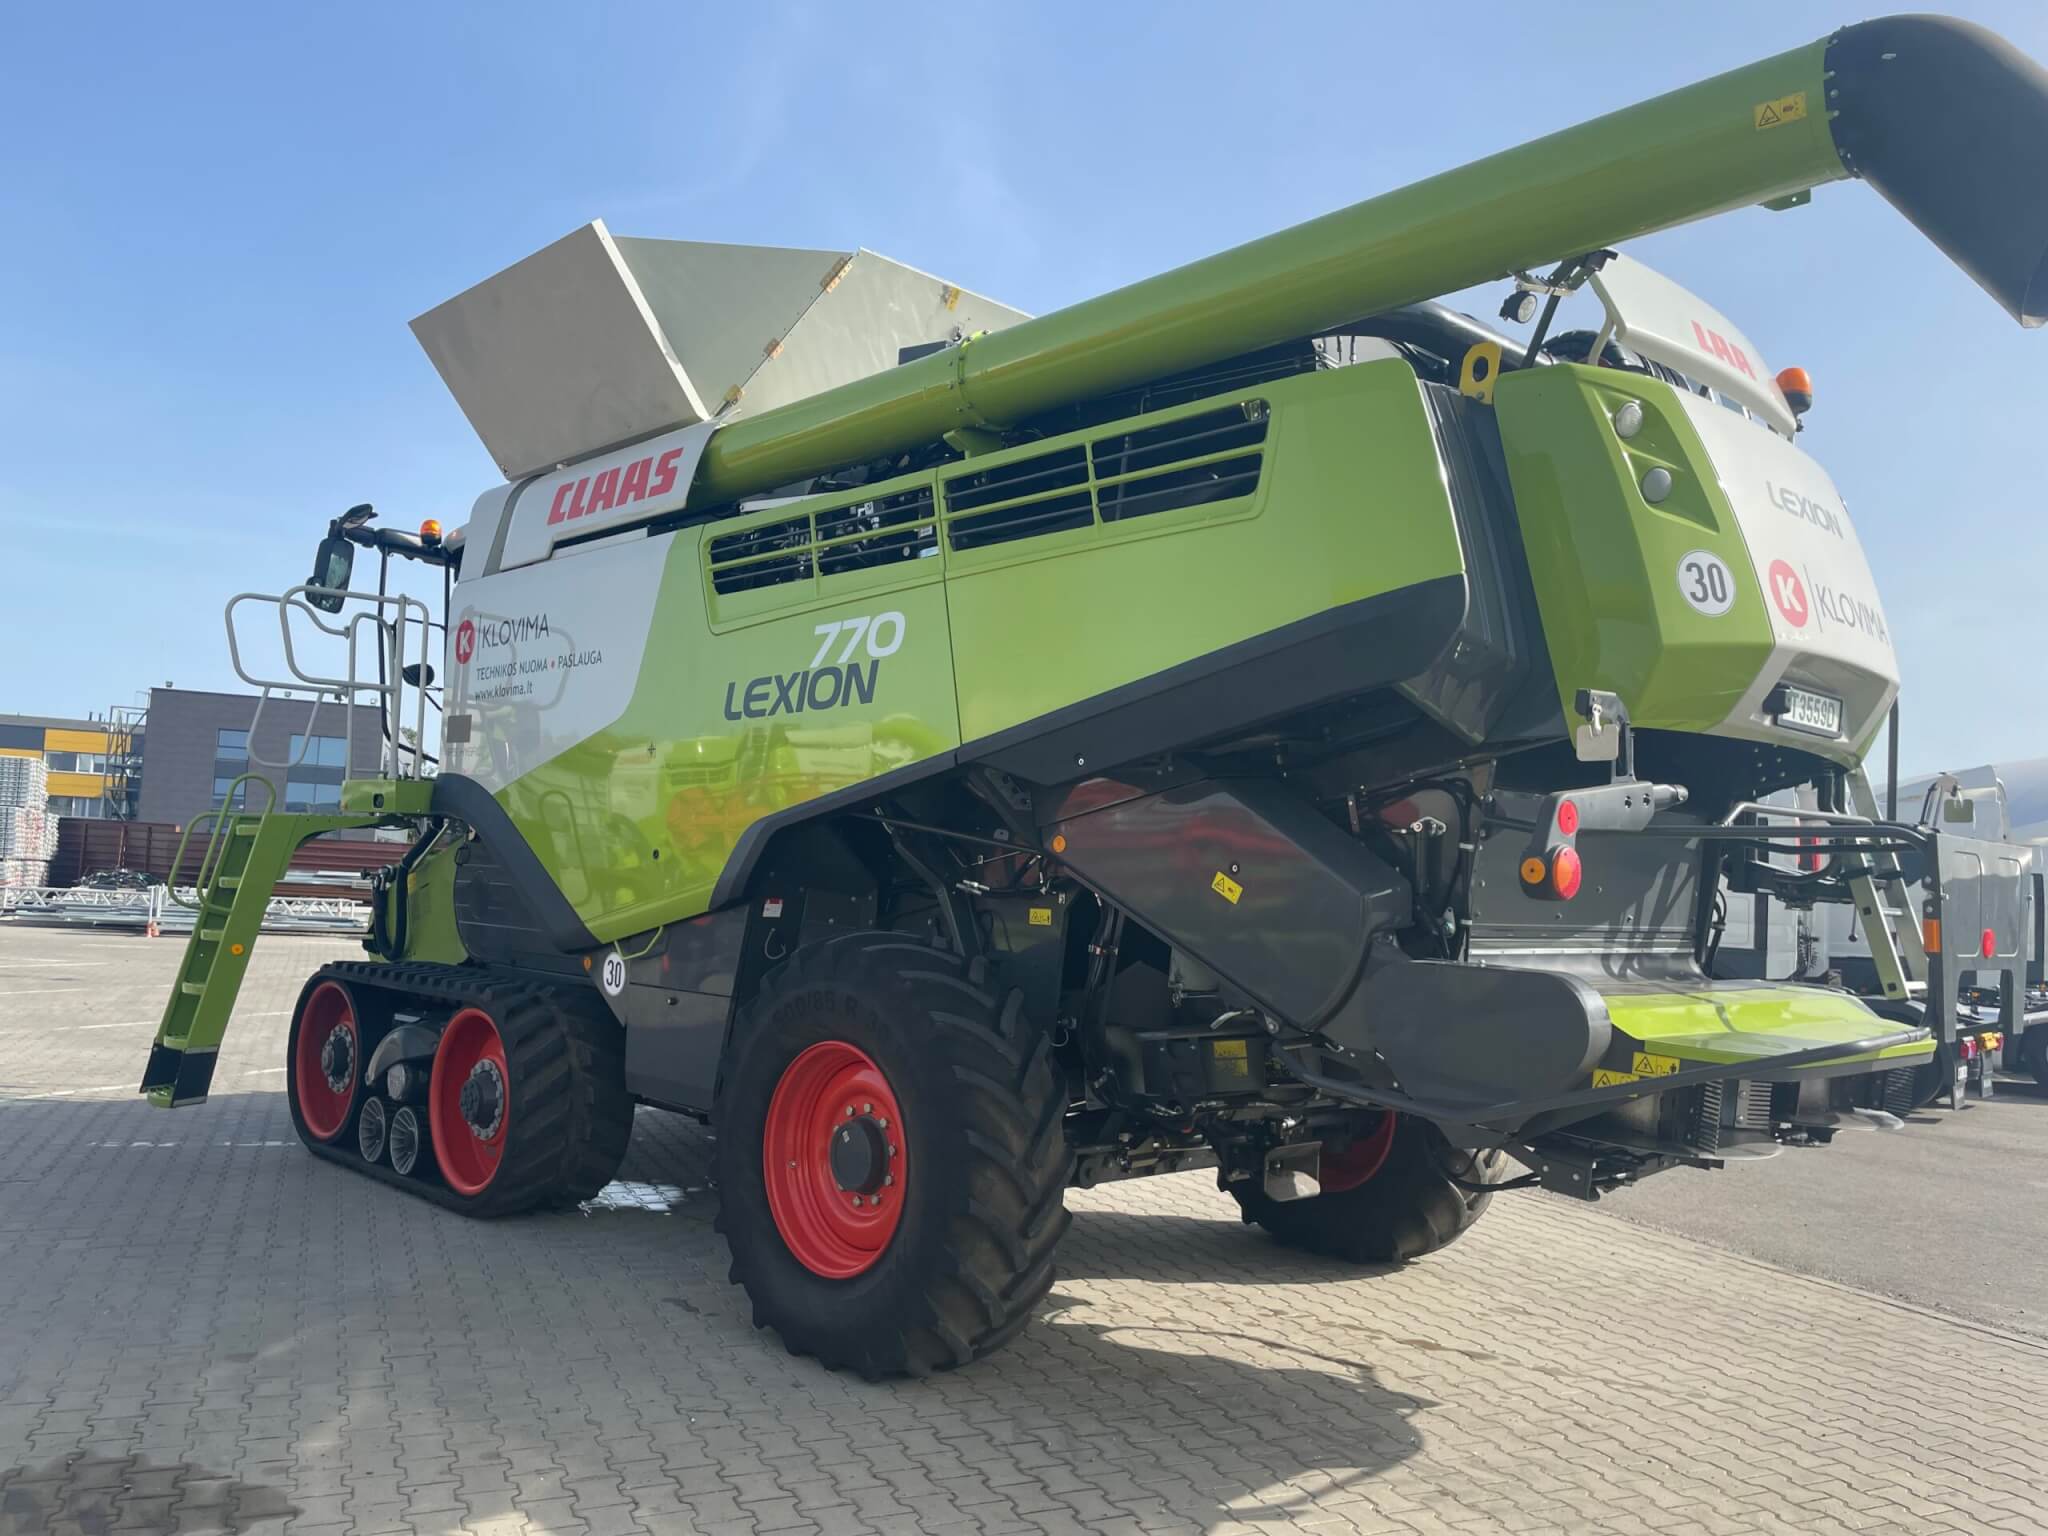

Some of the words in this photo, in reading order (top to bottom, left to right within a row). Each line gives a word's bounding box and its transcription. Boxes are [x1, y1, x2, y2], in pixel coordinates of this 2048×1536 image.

[547, 447, 684, 526] CLAAS
[1766, 480, 1844, 540] LEXION
[1685, 562, 1728, 604] 30
[459, 631, 472, 655] K
[482, 613, 550, 650] KLOVIMA
[1774, 574, 1803, 614] K
[1815, 582, 1889, 644] KLOVIMA
[809, 611, 906, 669] 770
[476, 660, 517, 681] TECHNIKOS
[519, 660, 548, 675] NUOMA
[557, 650, 602, 669] PASLAUGA
[724, 659, 881, 721] LEXION
[474, 681, 534, 702] www.klovima.lt
[606, 959, 622, 988] 30
